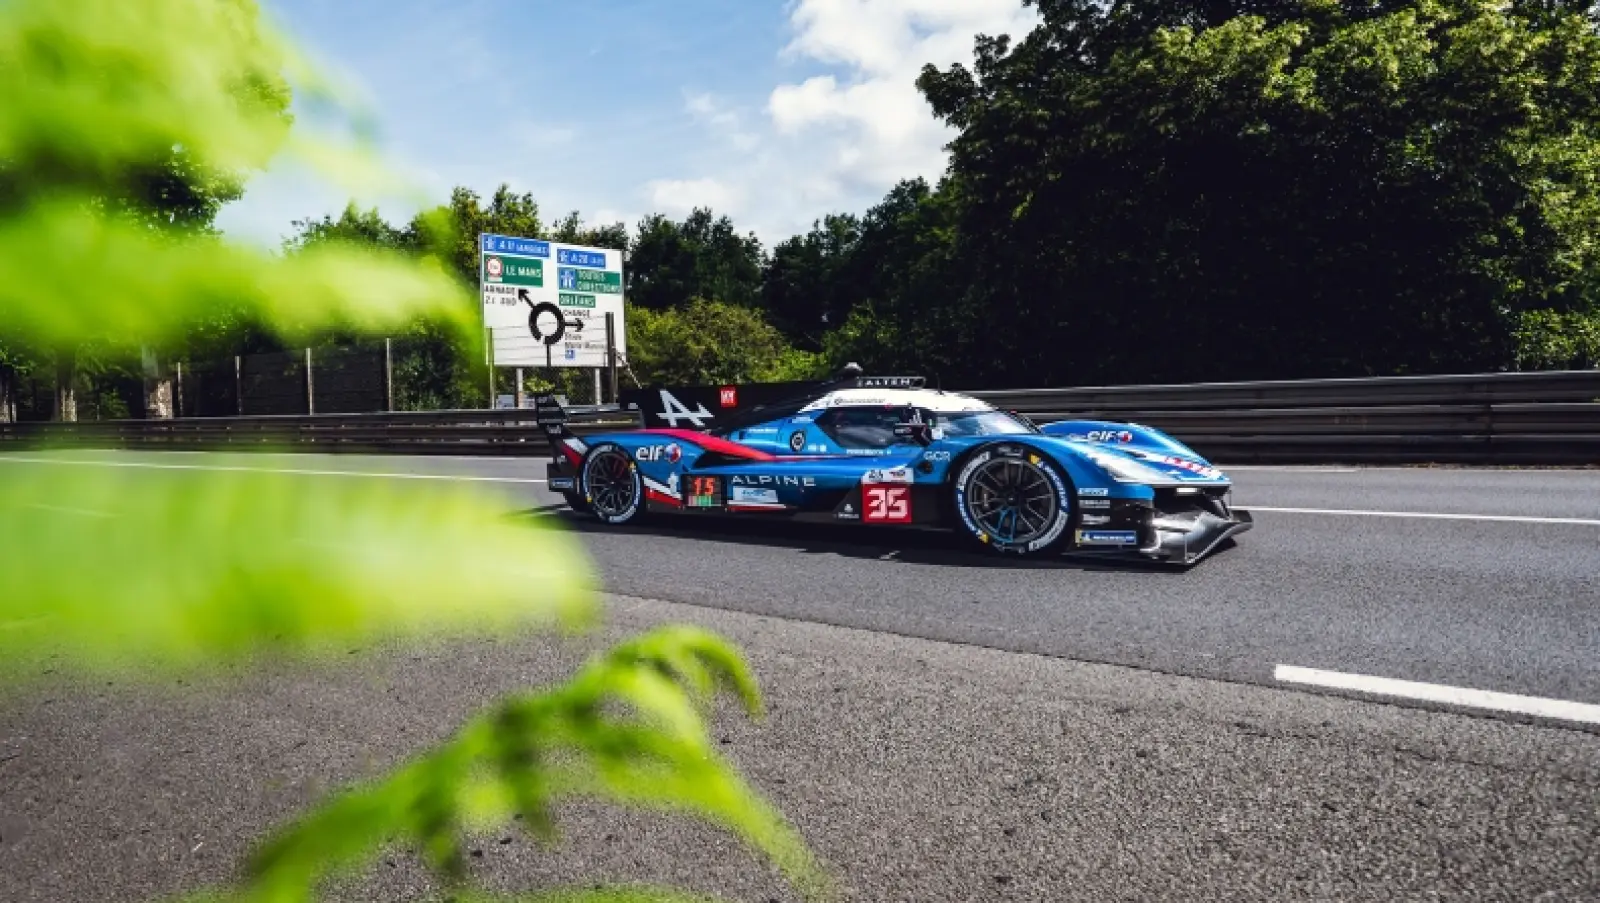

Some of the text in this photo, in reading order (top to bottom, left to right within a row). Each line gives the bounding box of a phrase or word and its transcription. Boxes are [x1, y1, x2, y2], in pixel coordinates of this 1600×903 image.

[505, 265, 541, 278] LE MANS
[636, 445, 664, 461] elf
[693, 477, 715, 495] 15
[731, 475, 817, 487] ALPINE
[867, 488, 908, 519] 35
